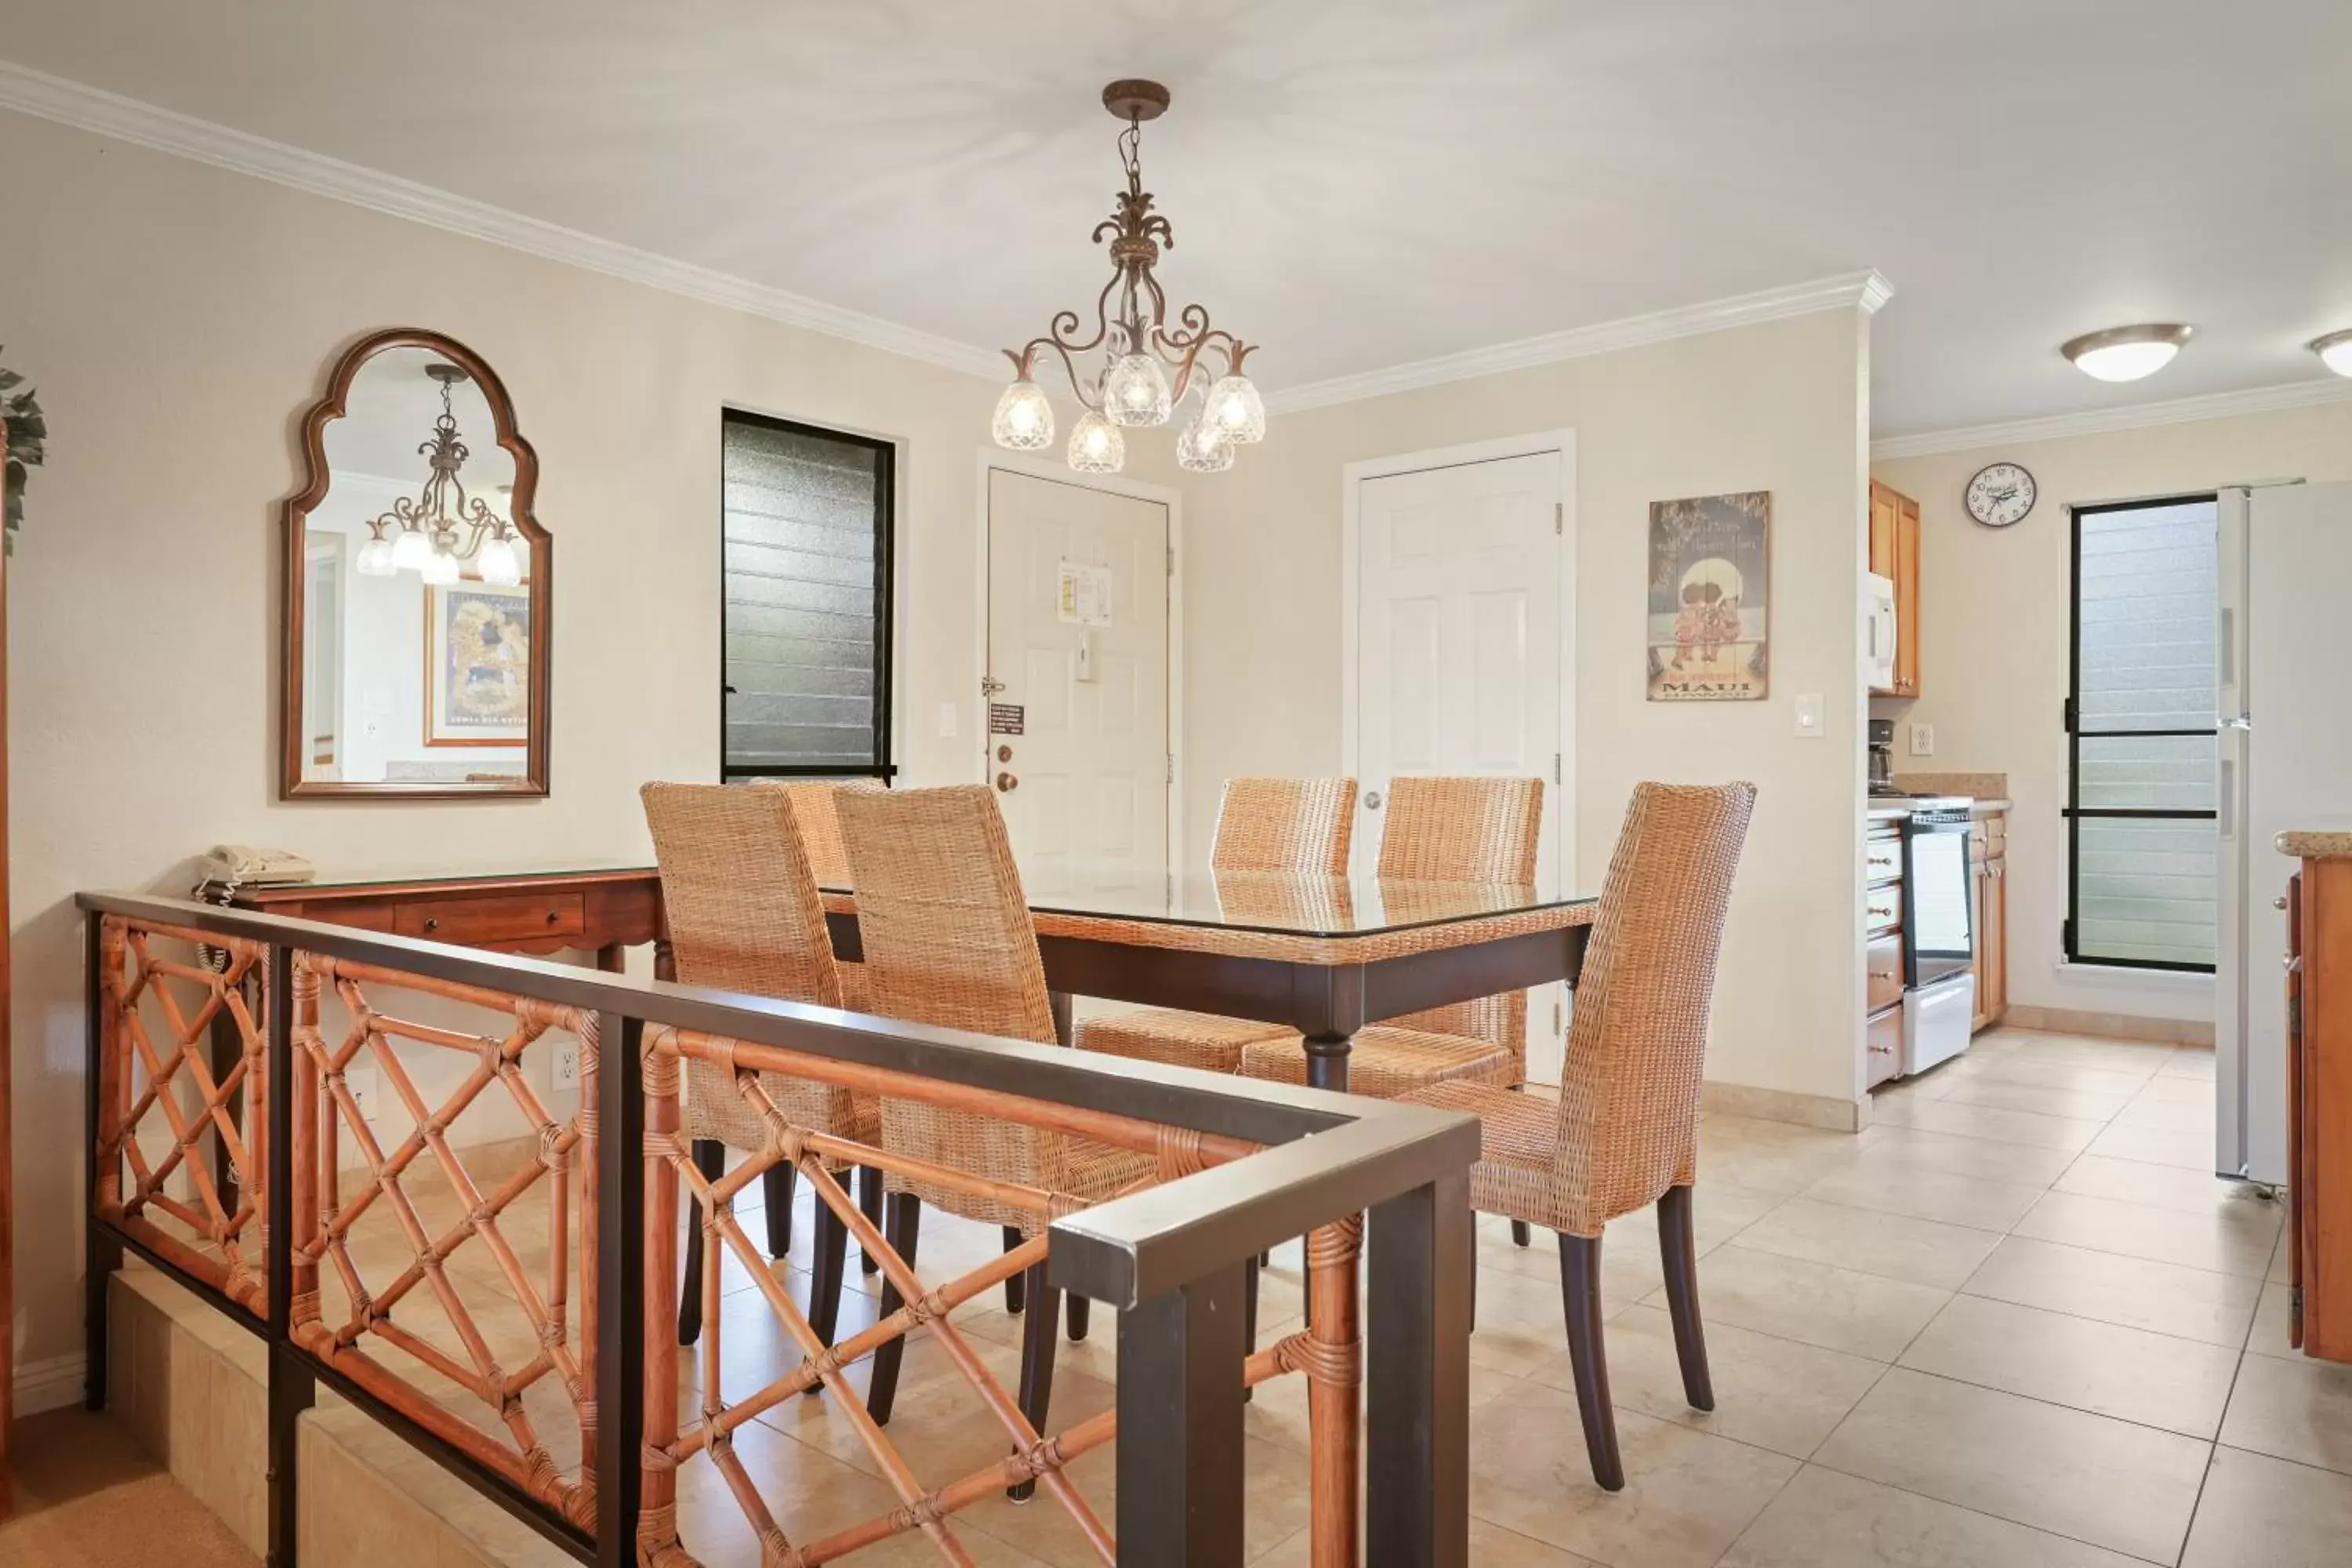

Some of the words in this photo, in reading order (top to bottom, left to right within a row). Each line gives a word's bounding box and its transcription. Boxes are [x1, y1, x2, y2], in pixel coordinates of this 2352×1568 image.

[1997, 468, 2005, 477] 12
[2024, 487, 2031, 496] 3
[1972, 494, 1980, 503] 9
[1976, 504, 1984, 514] 8
[2020, 500, 2027, 509] 4
[1998, 514, 2006, 524] 6
[1662, 682, 1751, 692] MAUI
